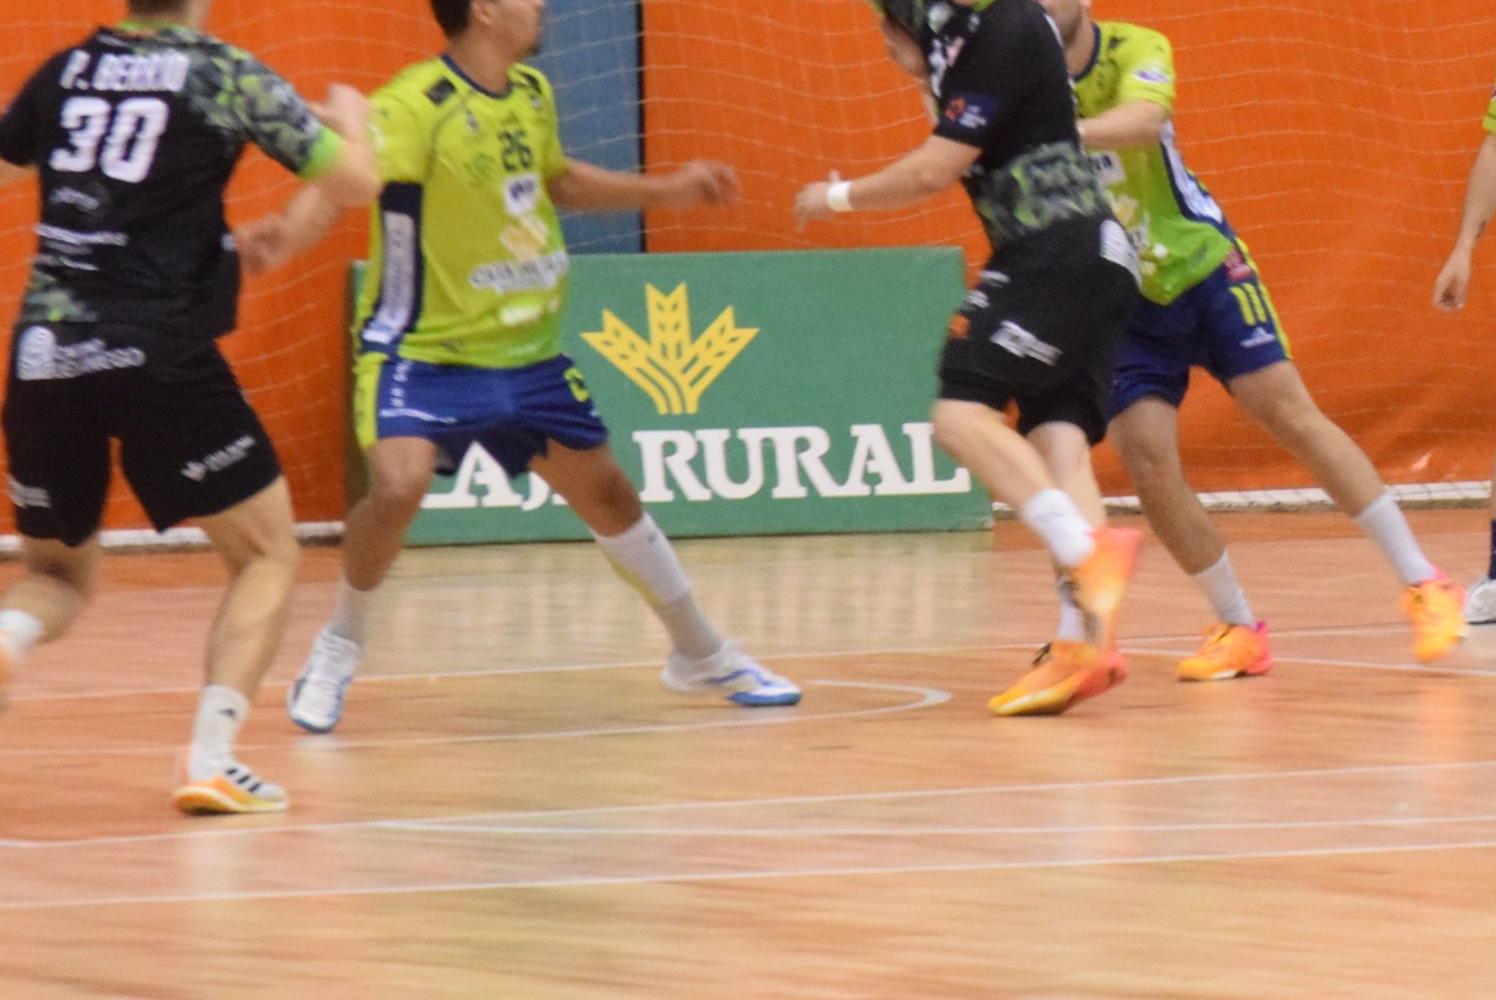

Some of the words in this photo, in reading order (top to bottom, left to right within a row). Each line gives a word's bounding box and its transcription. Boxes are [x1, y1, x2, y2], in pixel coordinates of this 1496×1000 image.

[50, 96, 168, 183] 30
[497, 128, 534, 171] 26
[632, 422, 970, 503] RURAL
